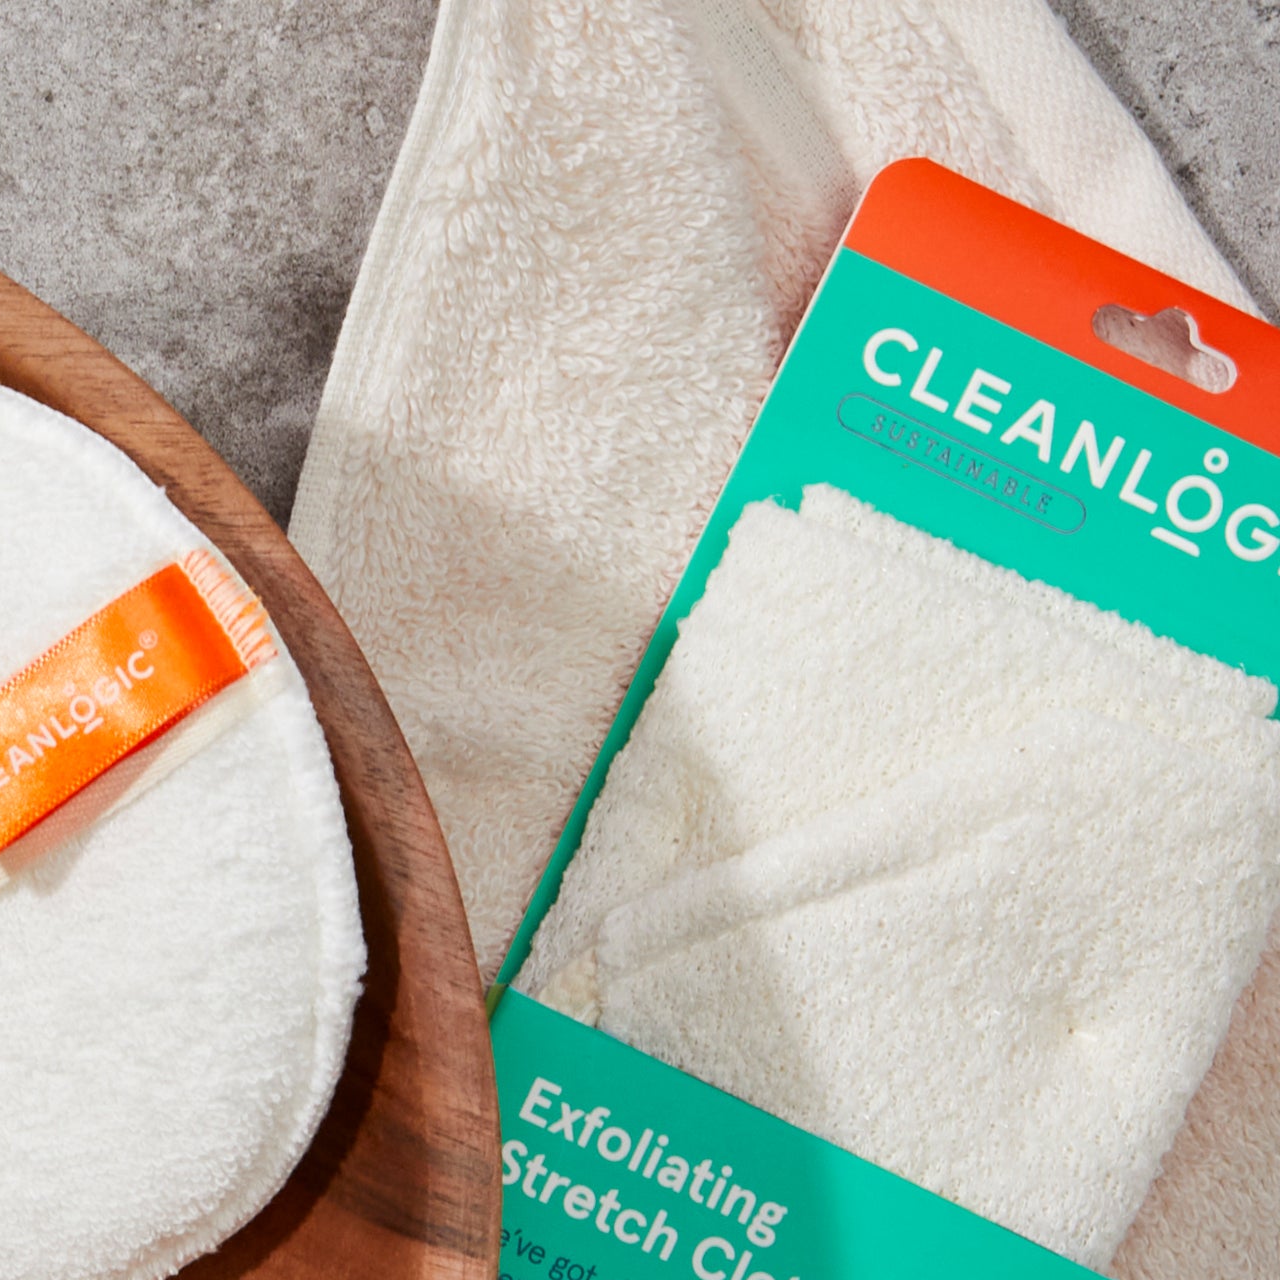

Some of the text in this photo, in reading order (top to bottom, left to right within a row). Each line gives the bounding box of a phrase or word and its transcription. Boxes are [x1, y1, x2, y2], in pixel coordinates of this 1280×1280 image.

[862, 327, 1280, 577] CLEANLOG
[871, 414, 1054, 515] SUSTAINABLE
[501, 1139, 679, 1262] Stretch
[517, 1076, 788, 1247] Exfoliating
[500, 1228, 546, 1264] e've
